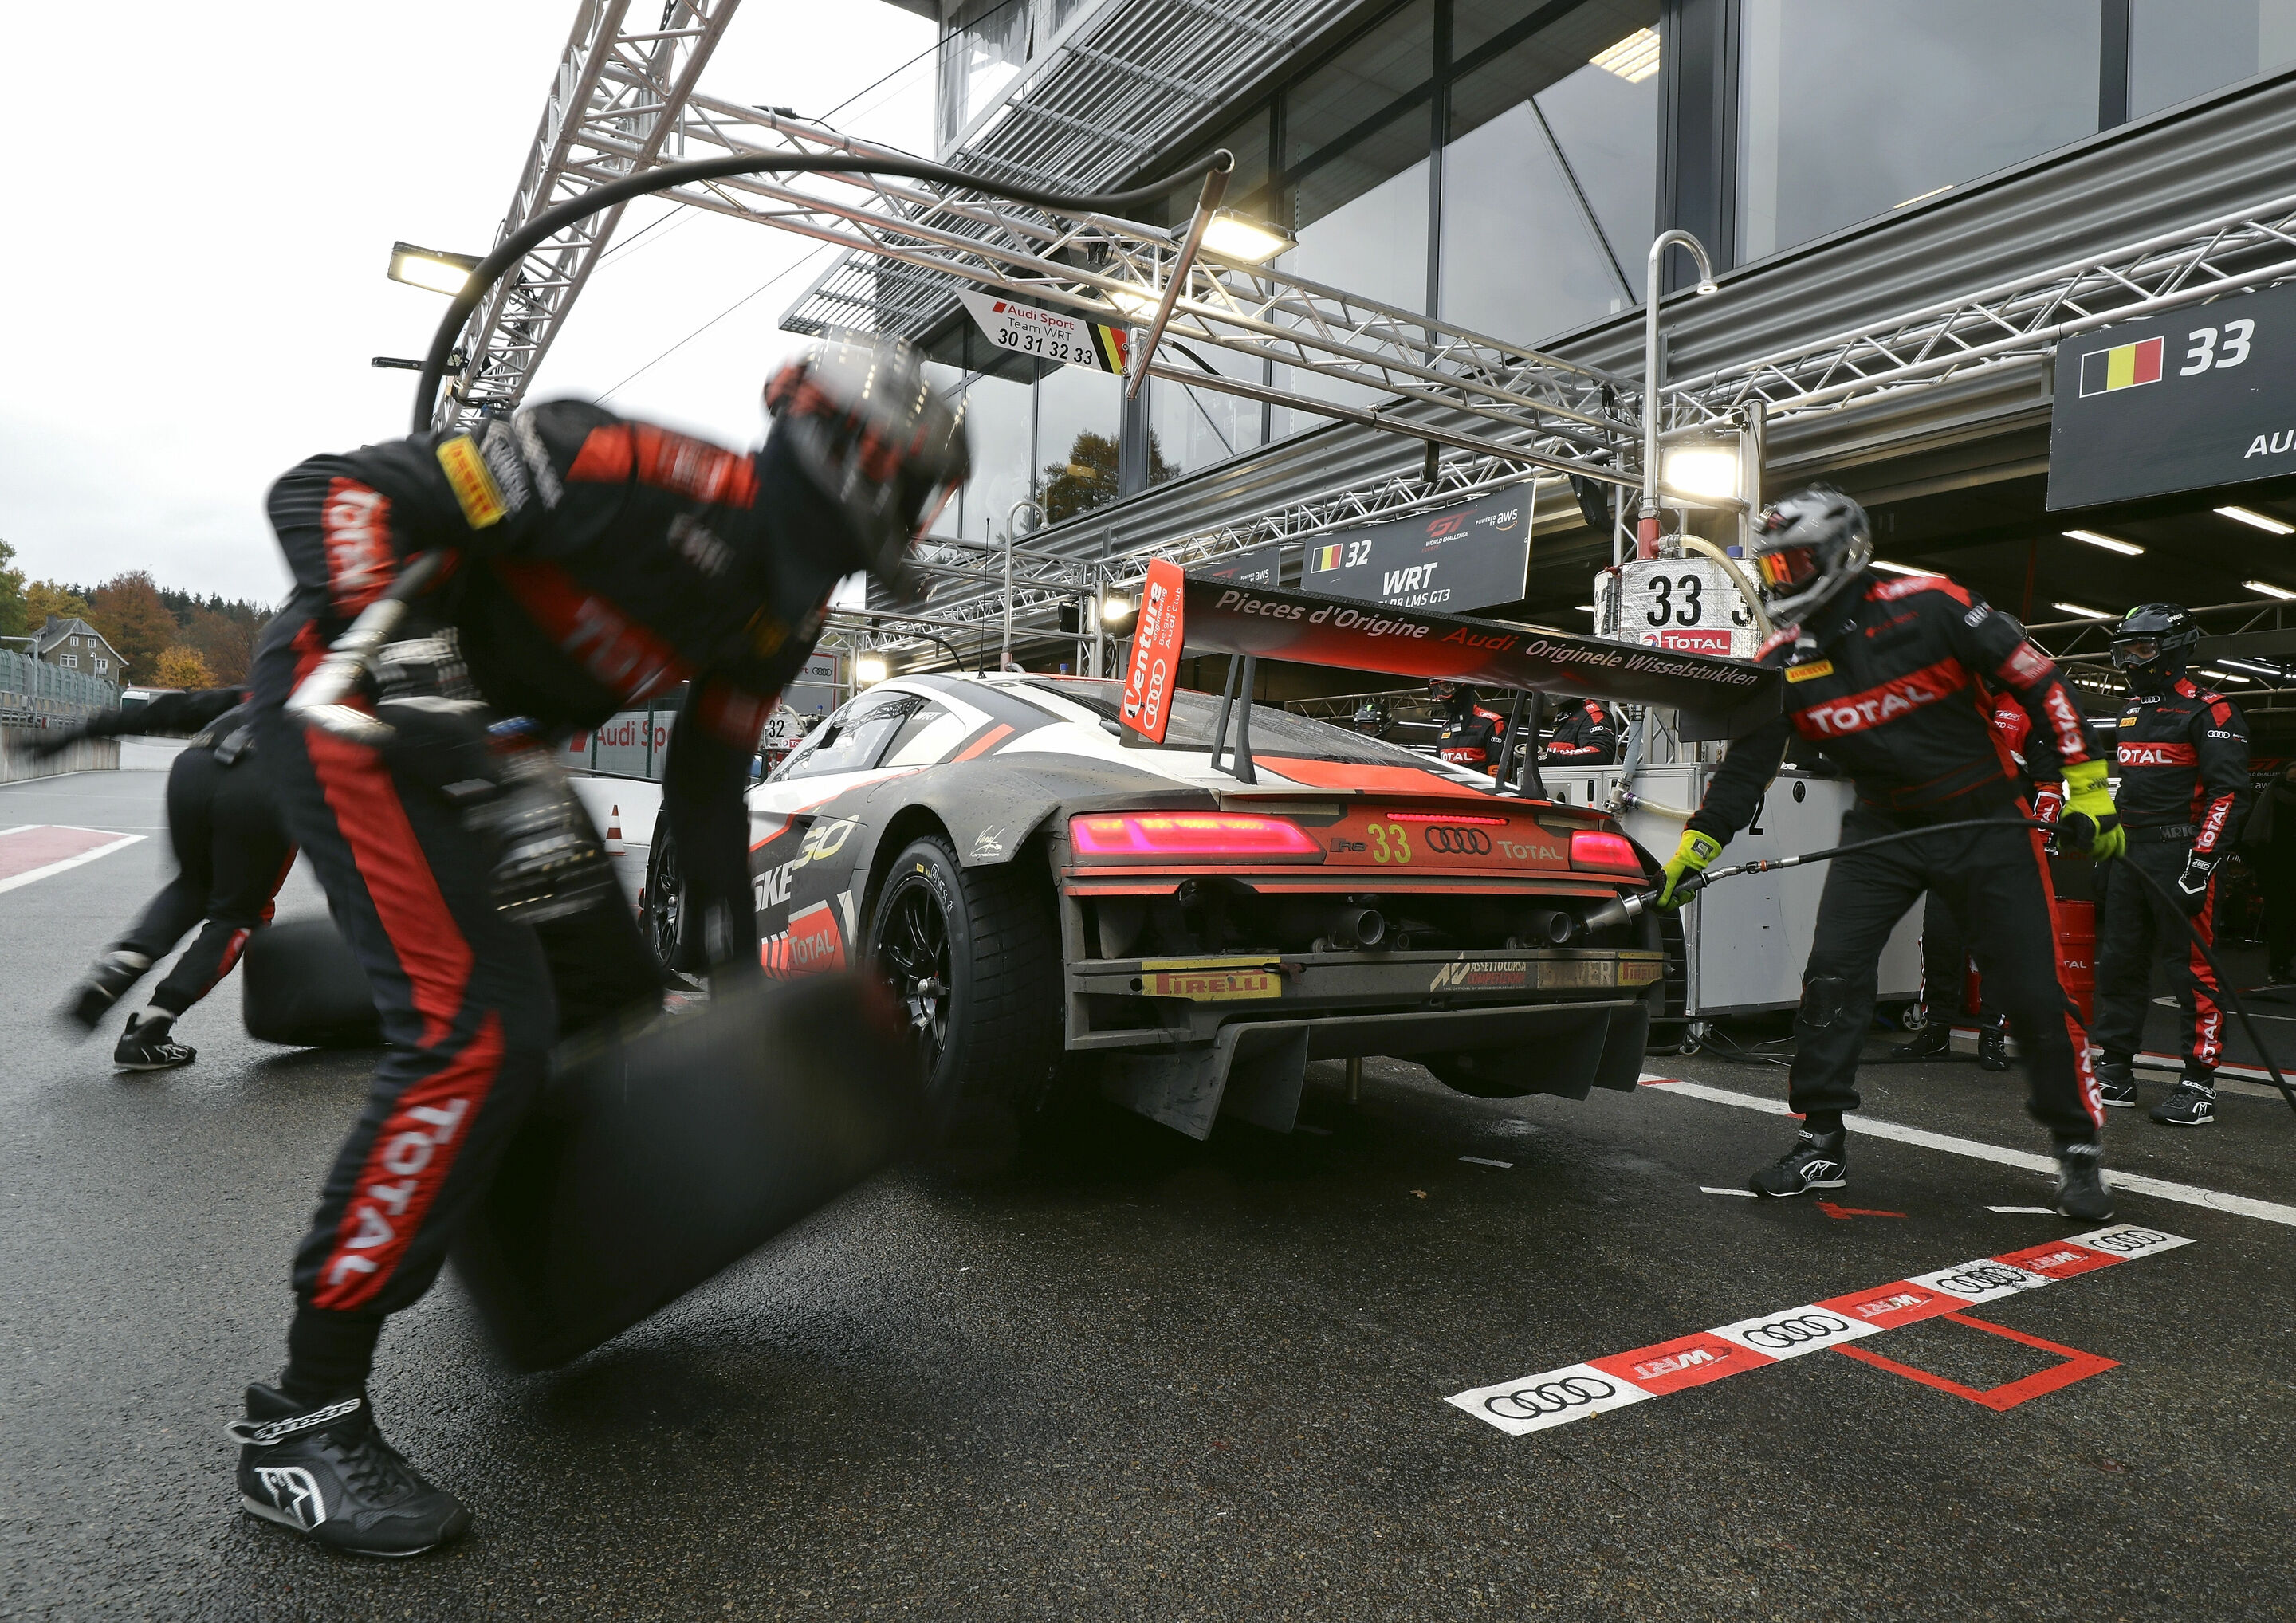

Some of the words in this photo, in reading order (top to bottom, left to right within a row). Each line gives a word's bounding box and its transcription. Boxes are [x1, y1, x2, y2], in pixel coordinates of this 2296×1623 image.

[1007, 316, 1040, 334] Team
[1044, 327, 1072, 341] WRT
[1008, 305, 1036, 320] Audi
[1040, 312, 1075, 330] Sport
[998, 328, 1019, 347] 30
[1024, 336, 1043, 353] 31
[1049, 341, 1069, 360] 32
[1074, 347, 1093, 365] 33
[2179, 318, 2255, 376] 33
[2243, 429, 2296, 458] AU
[1476, 515, 1496, 525] POWERED
[1497, 509, 1518, 524] aws
[1345, 539, 1372, 568] 32
[1425, 537, 1442, 547] WORLD
[1443, 531, 1468, 543] CHALLENGE
[1255, 568, 1269, 580] aws
[1382, 561, 1438, 596] WRT
[1405, 592, 1429, 608] LMS
[1429, 588, 1451, 604] GT3
[1646, 575, 1702, 627] 33
[1153, 588, 1168, 641] engineering
[1158, 605, 1172, 646] Belgian
[1165, 615, 1176, 649] Audi
[1172, 587, 1181, 612] Club
[2167, 613, 2184, 623] uvex
[1123, 581, 1162, 719] Venture
[1215, 591, 1306, 620] Pieces
[1308, 606, 1429, 639] d'Origine
[1441, 627, 1520, 651] Audi
[1524, 640, 1624, 667] Originele
[1623, 654, 1759, 686] Wisselstukken
[1664, 635, 1728, 650] TOTAL
[1807, 685, 1936, 733] TOTAL
[2049, 690, 2082, 754] TOTAL
[769, 719, 785, 738] 32
[1440, 751, 1473, 761] TOTAL
[2117, 746, 2173, 764] TOTAL
[2196, 802, 2230, 849] TOTAL
[1339, 840, 1366, 852] R8
[1367, 823, 1413, 863] 33
[1497, 840, 1564, 861] TOTAL
[2192, 860, 2211, 870] OMP
[788, 929, 836, 965] TOTAL
[1156, 969, 1268, 995] PIRELLI
[2198, 1012, 2218, 1063] TOTAL
[327, 1098, 471, 1286] TOTAL
[1856, 1294, 1922, 1318] WRT
[1634, 1350, 1716, 1381] WRT
